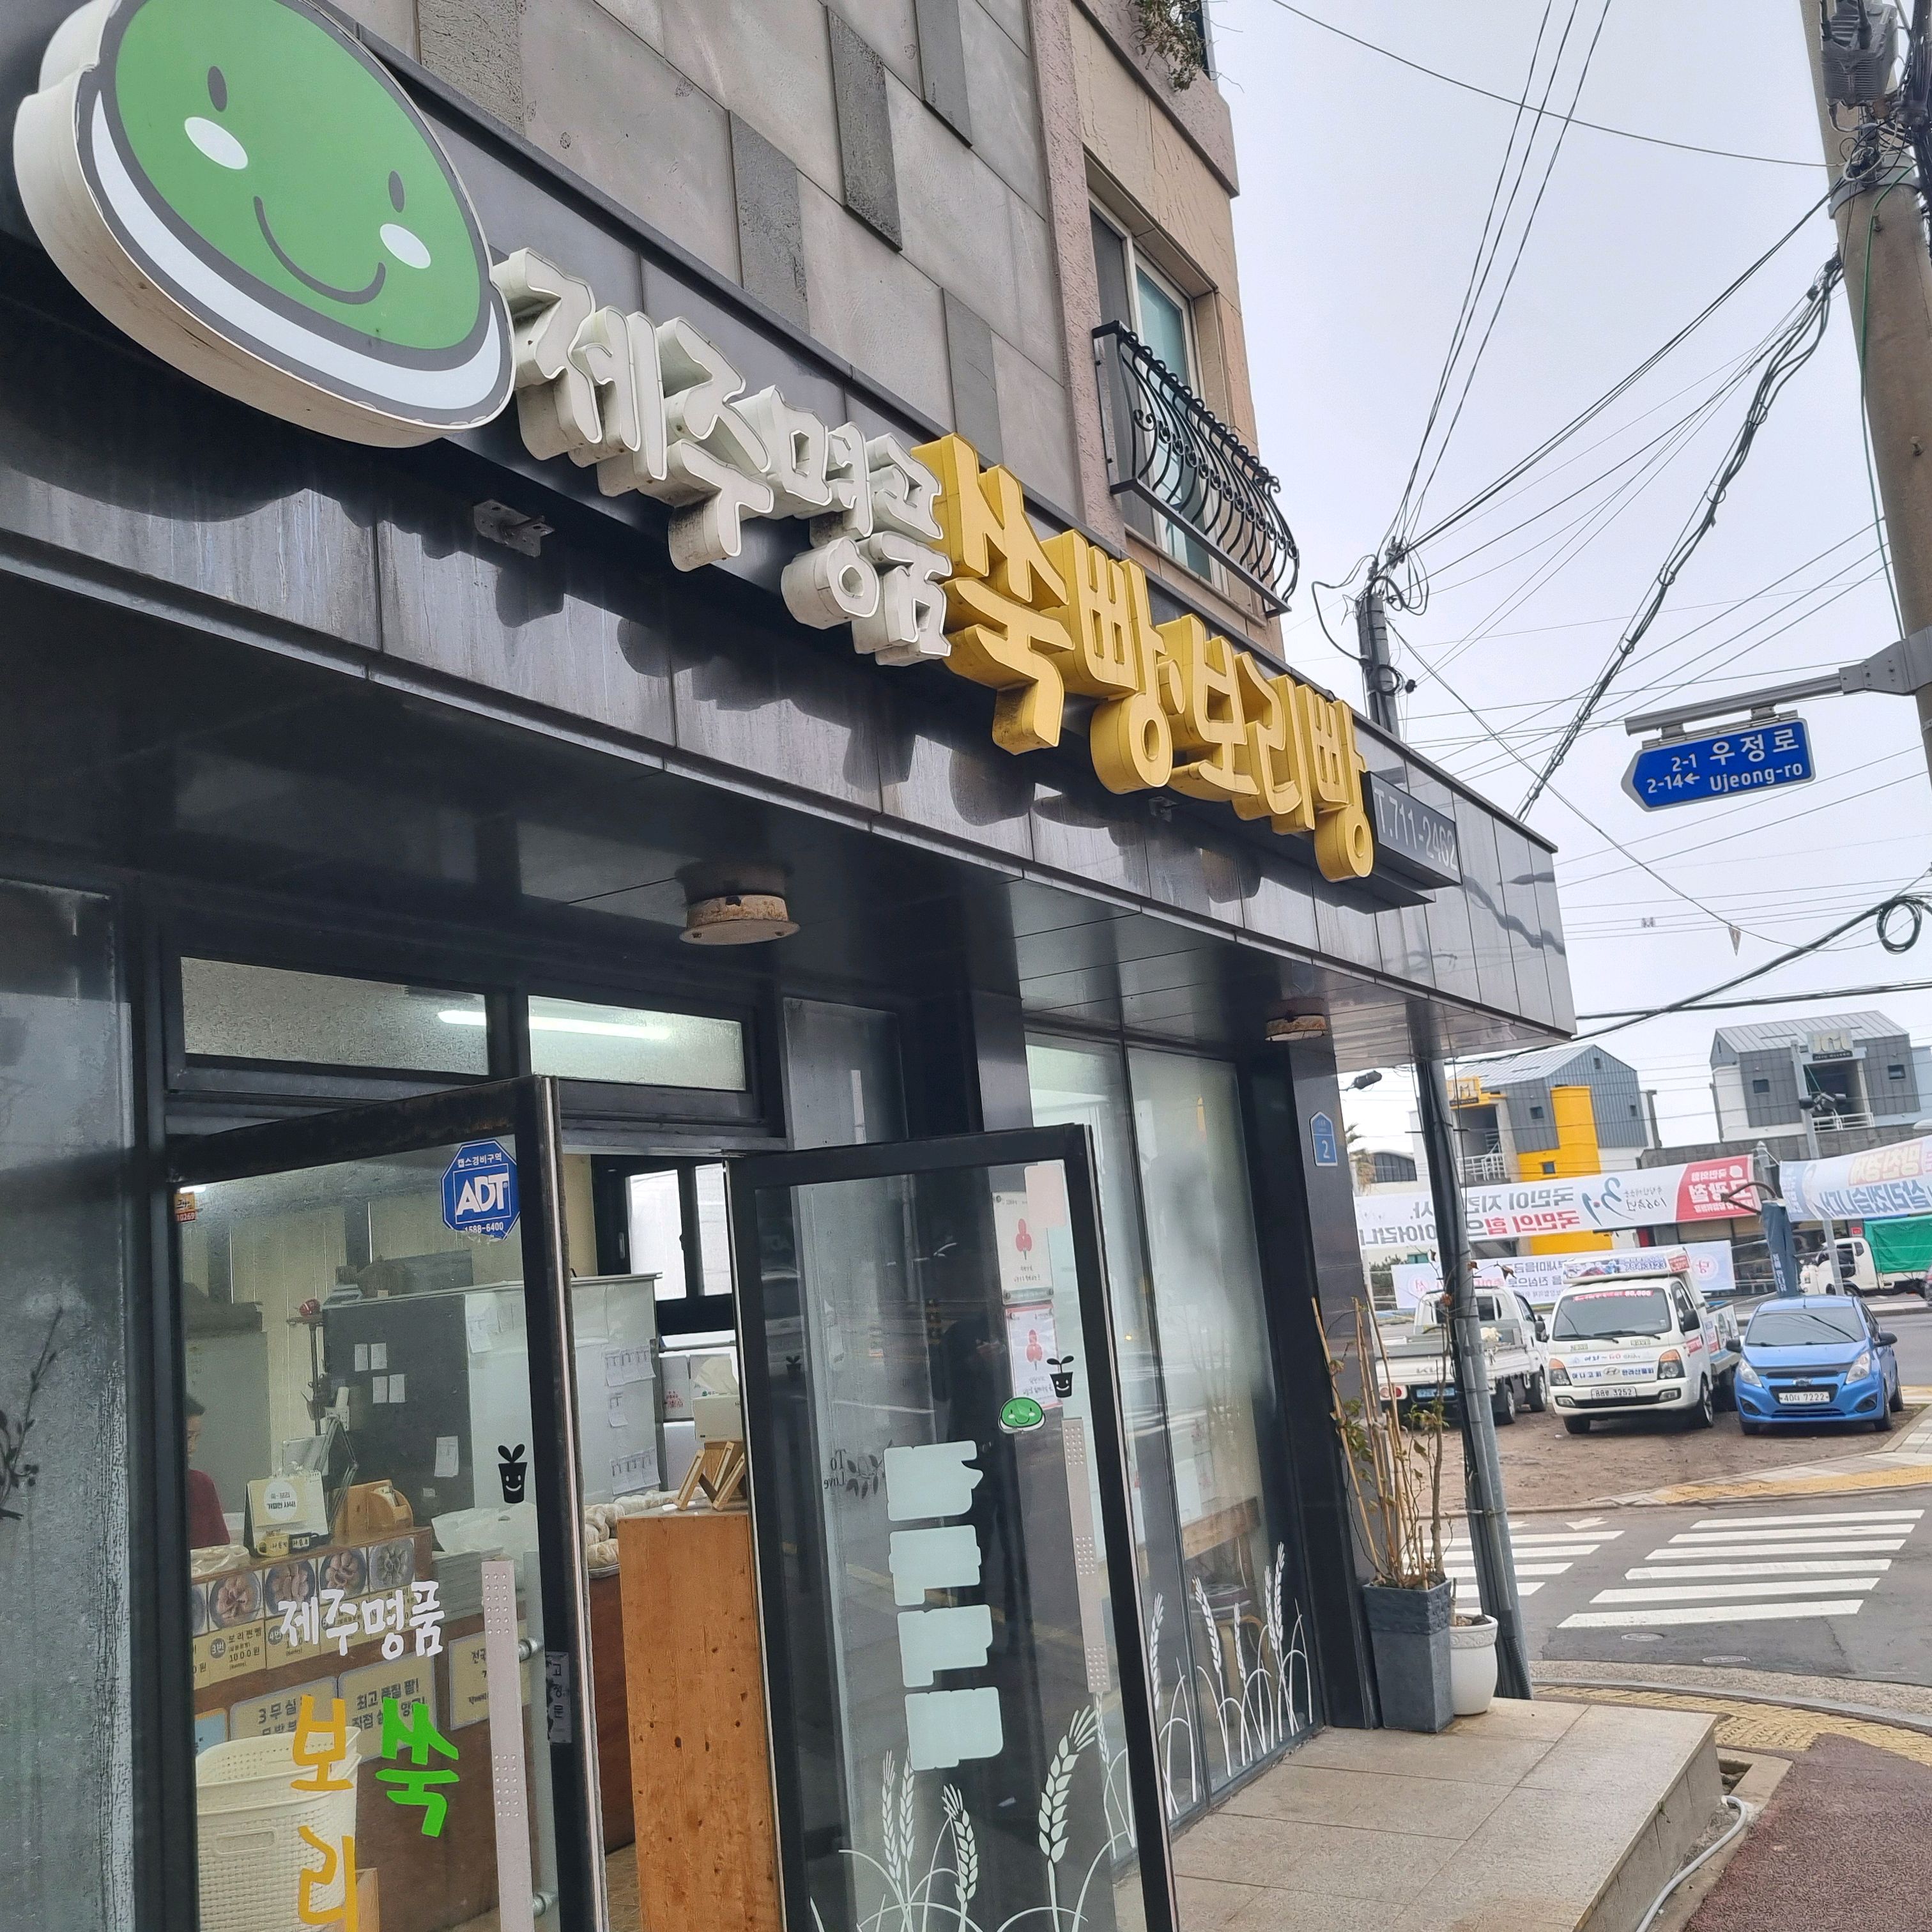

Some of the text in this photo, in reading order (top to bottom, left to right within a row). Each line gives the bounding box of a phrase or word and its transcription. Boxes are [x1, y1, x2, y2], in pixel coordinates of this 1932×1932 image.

[495, 248, 954, 666] 제주명품
[1671, 729, 1800, 772] 2-1 우정로
[1646, 763, 1803, 794] 2-14 Ujeong-ro
[457, 1152, 502, 1168] 캡스경비구역
[1322, 1140, 1330, 1159] 2
[456, 1172, 510, 1216] ADT
[1803, 1393, 1825, 1401] 7222
[278, 1581, 445, 1660] 제주명품
[211, 1640, 225, 1655] 3번
[229, 1646, 261, 1662] 1000원
[356, 1690, 378, 1711] 최고
[375, 1696, 460, 1837] 쑥
[291, 1694, 359, 1932] 보리
